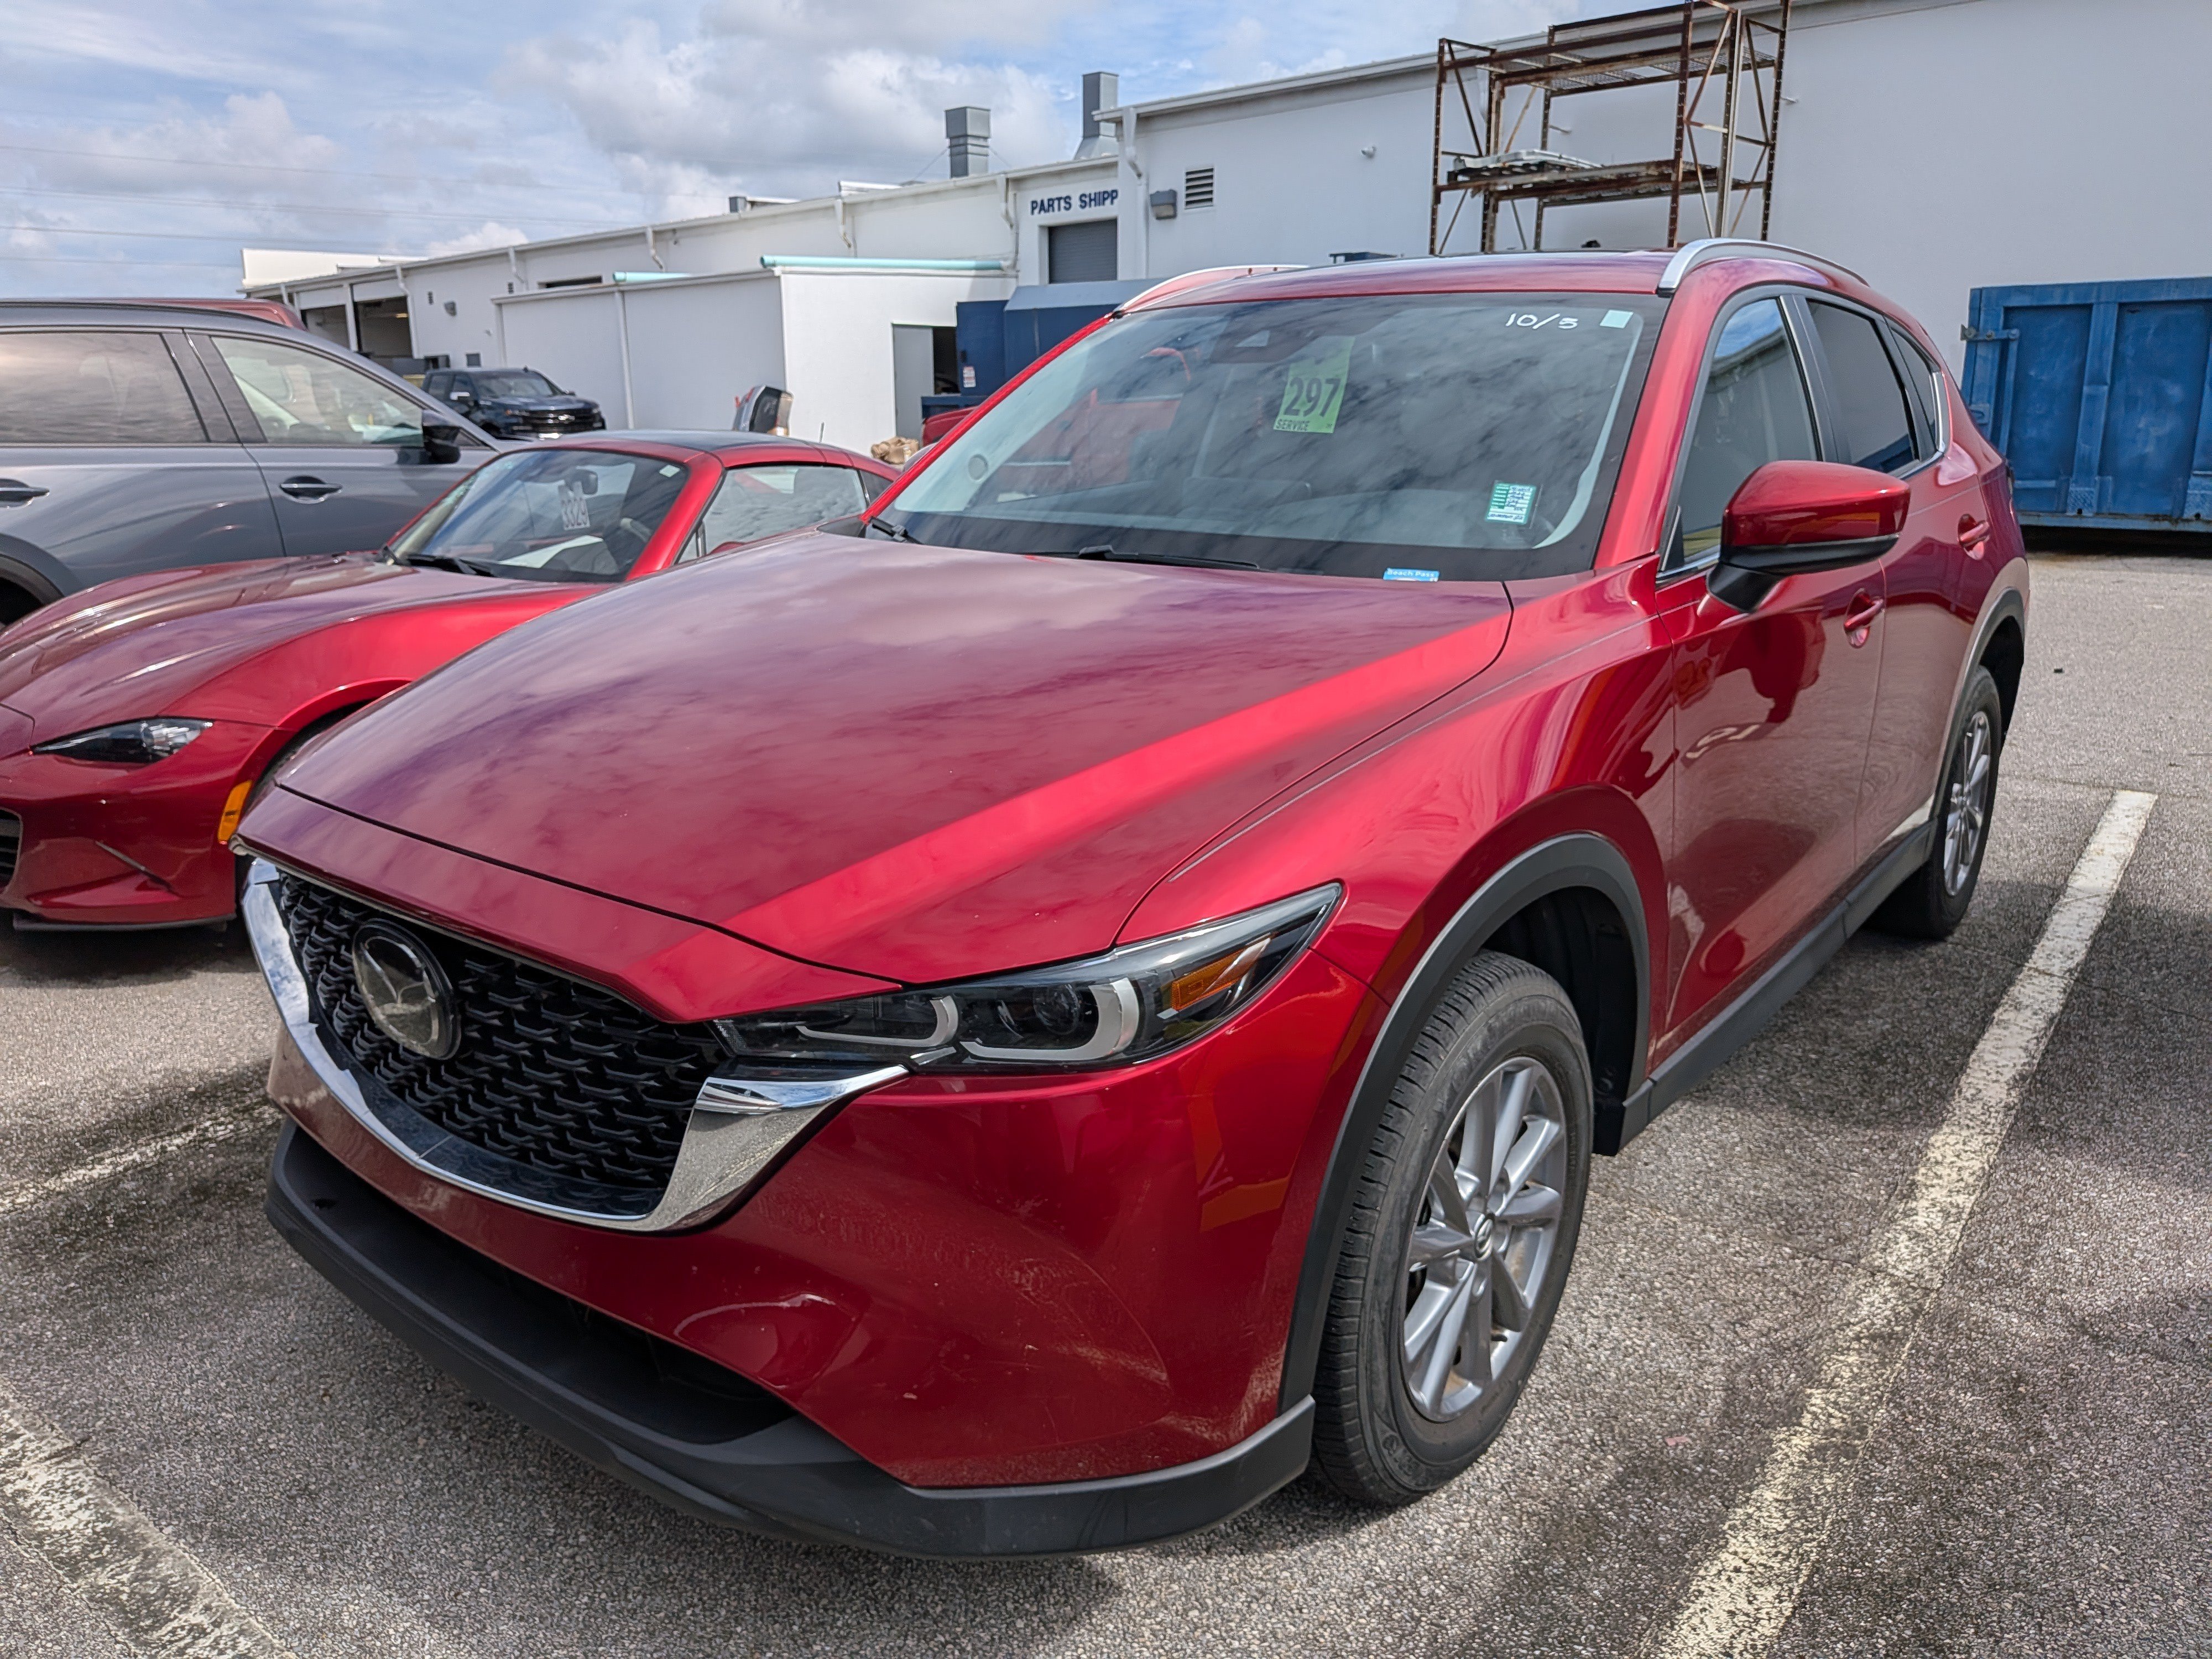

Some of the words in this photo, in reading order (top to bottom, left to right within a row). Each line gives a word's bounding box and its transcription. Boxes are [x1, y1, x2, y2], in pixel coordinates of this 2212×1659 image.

[1030, 195, 1072, 216] PARTS
[1078, 189, 1119, 210] SHIPP
[1505, 313, 1579, 330] 10/5
[1284, 377, 1342, 418] 297
